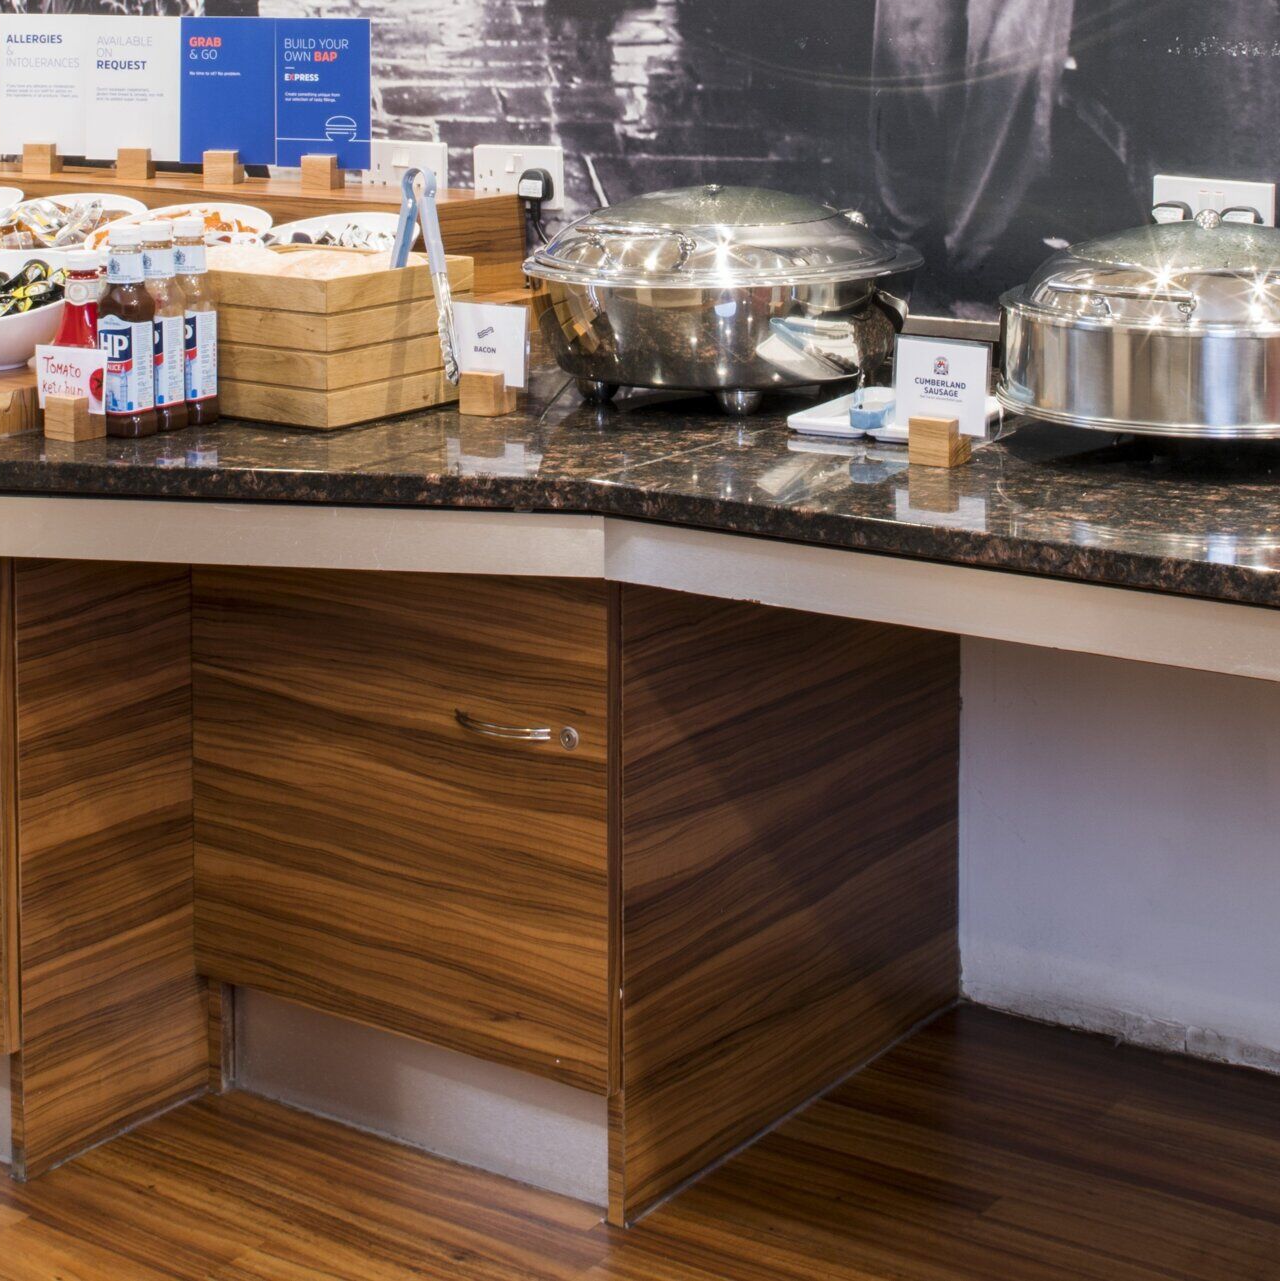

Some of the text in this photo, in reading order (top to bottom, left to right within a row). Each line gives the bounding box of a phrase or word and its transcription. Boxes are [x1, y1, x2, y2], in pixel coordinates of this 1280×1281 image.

[6, 34, 63, 44] ALLERGIES
[97, 36, 153, 47] AVAILABLE
[189, 36, 222, 48] GRAB
[284, 38, 349, 50] BUILD YOUR
[6, 46, 14, 56] &
[96, 48, 113, 58] ON
[189, 49, 218, 60] & GO
[284, 50, 337, 62] OWN BAP
[6, 57, 80, 68] INTOLERANCES
[96, 60, 148, 71] REQUEST
[284, 73, 319, 82] EXPRESS
[100, 333, 129, 359] HP
[473, 345, 497, 355] BACON
[106, 363, 123, 373] AUCE
[914, 376, 967, 390] CUMBERLAND
[924, 386, 959, 398] SAUSAGE
